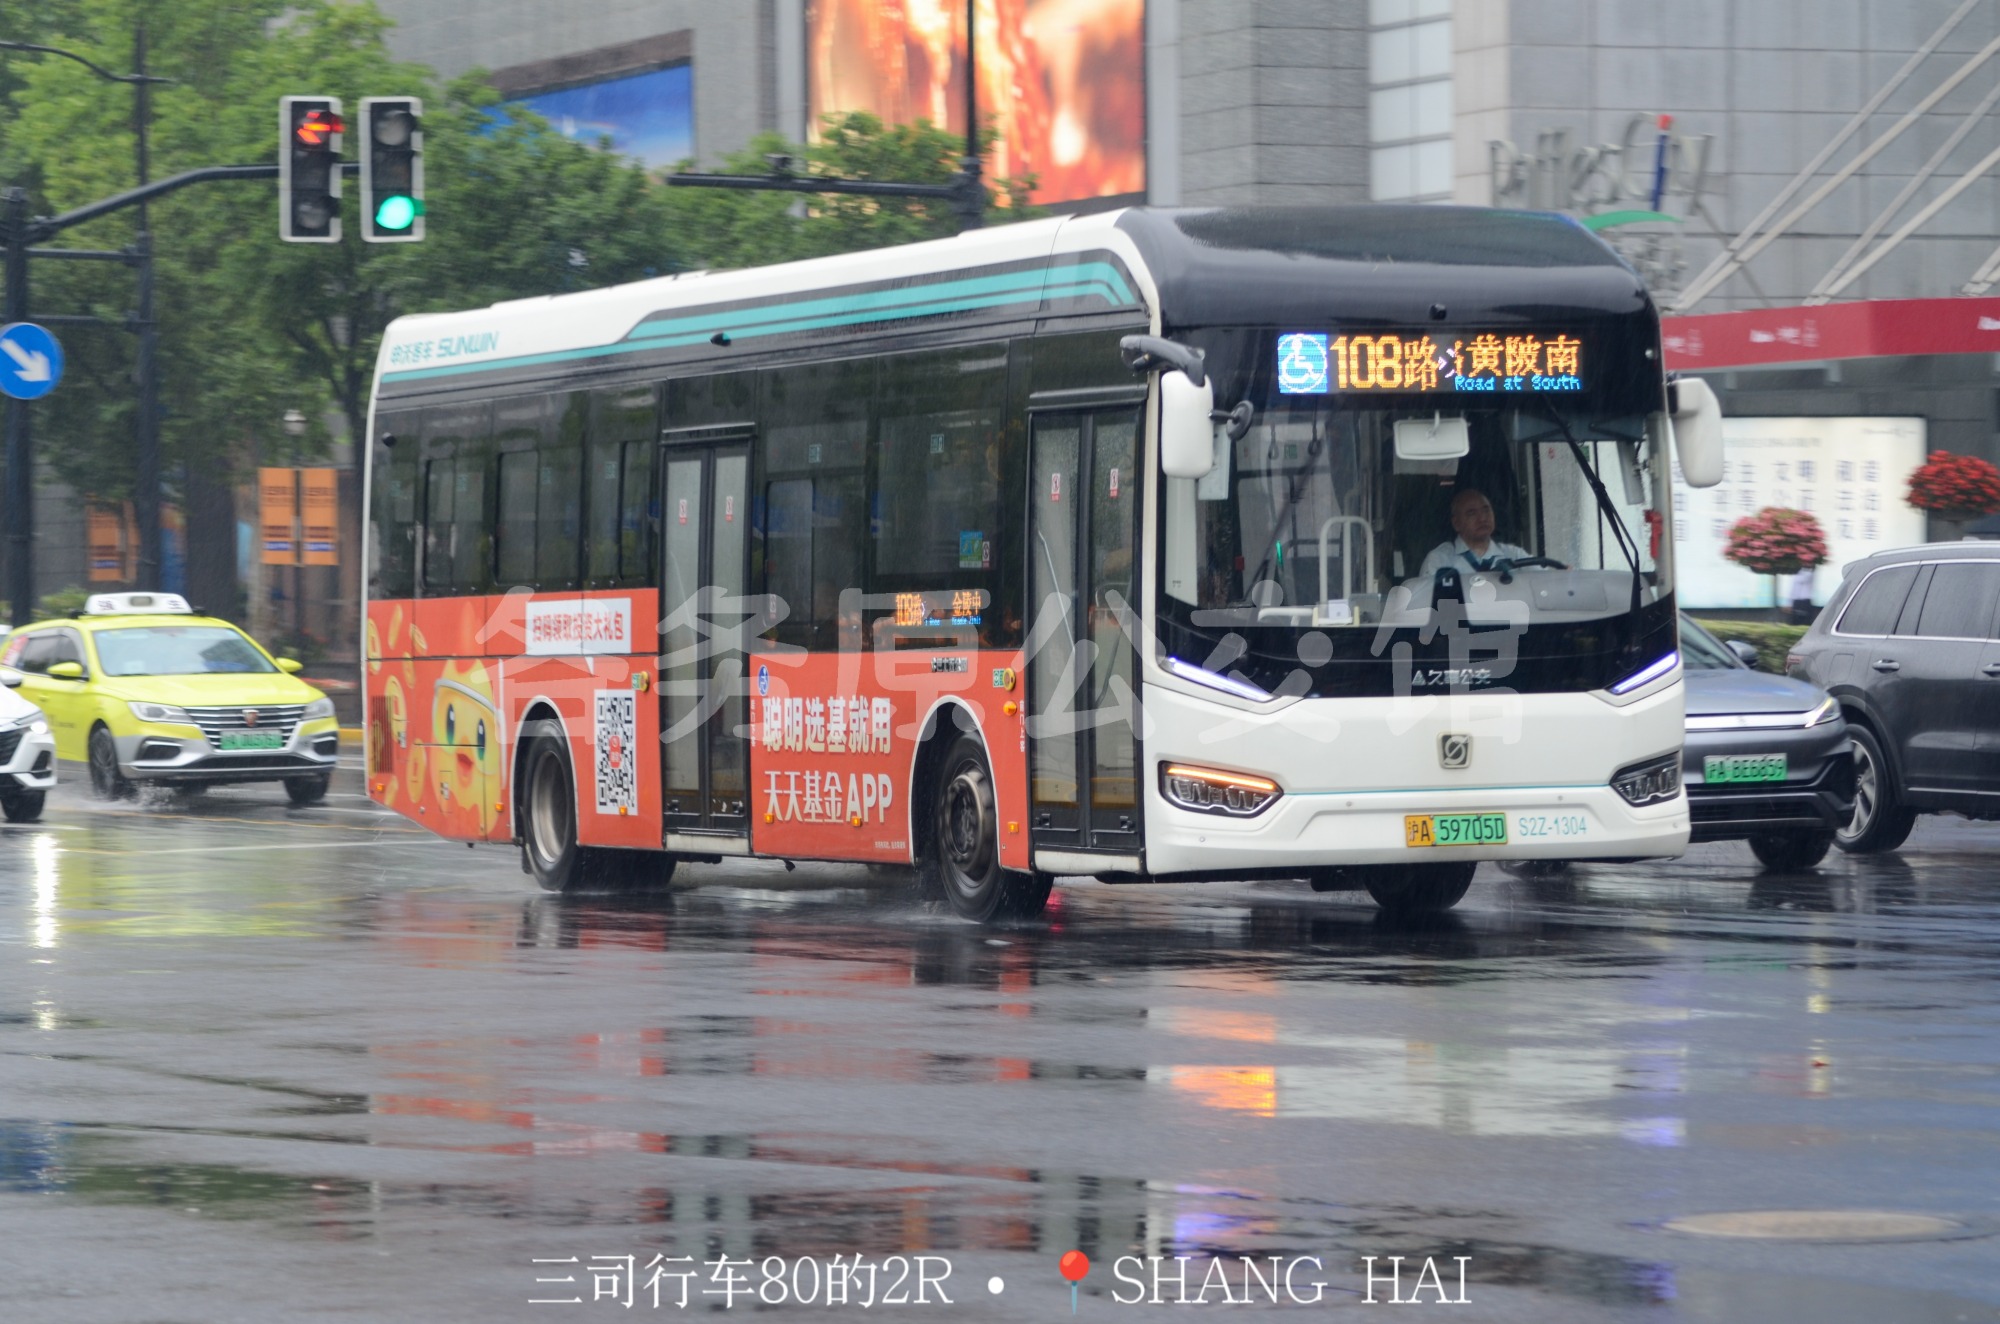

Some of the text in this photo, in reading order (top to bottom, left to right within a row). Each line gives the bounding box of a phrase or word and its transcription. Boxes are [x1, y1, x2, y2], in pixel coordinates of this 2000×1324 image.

[436, 331, 500, 358] SUNWIN
[1330, 335, 1438, 390] 108路
[1454, 374, 1581, 391] Road at South
[1428, 668, 1492, 685] 久事公交
[762, 695, 892, 755] 聪明选基就用
[763, 770, 894, 824] 天天基金APP
[1439, 817, 1506, 841] 59705D
[1518, 816, 1588, 836] S2Z-1304
